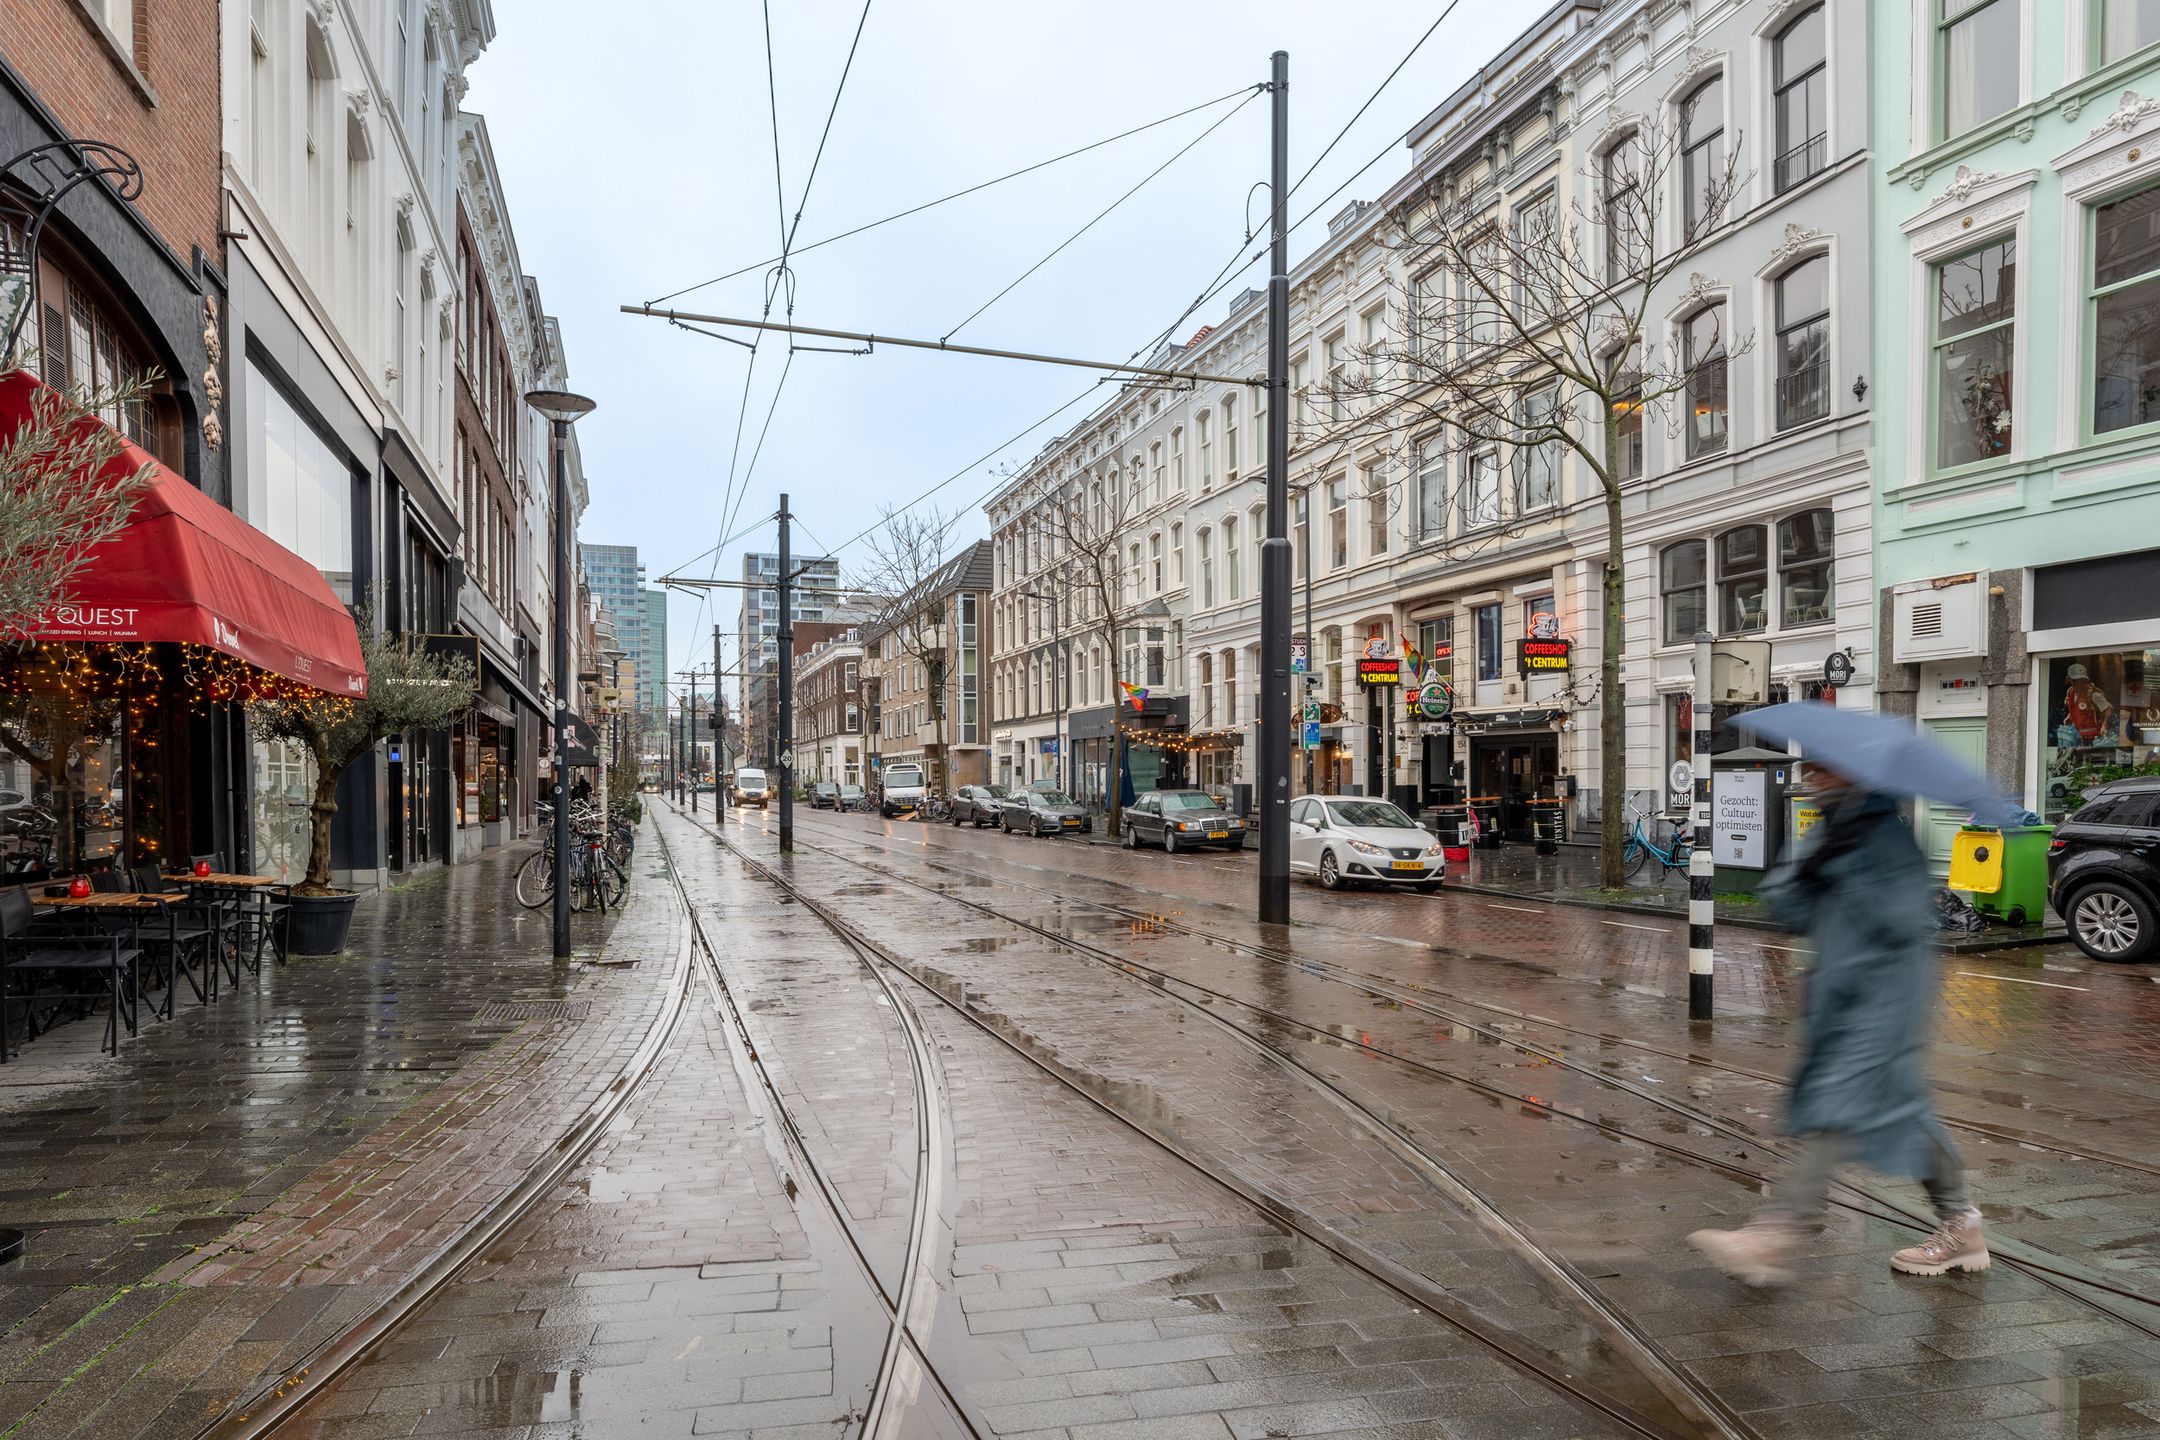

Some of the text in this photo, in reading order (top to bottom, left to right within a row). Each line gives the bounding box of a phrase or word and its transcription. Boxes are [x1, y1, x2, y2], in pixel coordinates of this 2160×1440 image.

[1524, 643, 1567, 655] COFFEESHOP
[1361, 662, 1398, 671] COFFEESHOP
[1532, 657, 1568, 668] CENTRUM
[1368, 673, 1398, 682] CENTRUM
[1830, 670, 1847, 679] MORI
[1421, 696, 1448, 704] Heineken
[1670, 793, 1691, 805] MOR
[1720, 795, 1759, 806] Gezocht:
[1721, 808, 1758, 819] Cultuur-
[1715, 820, 1763, 832] optimisten
